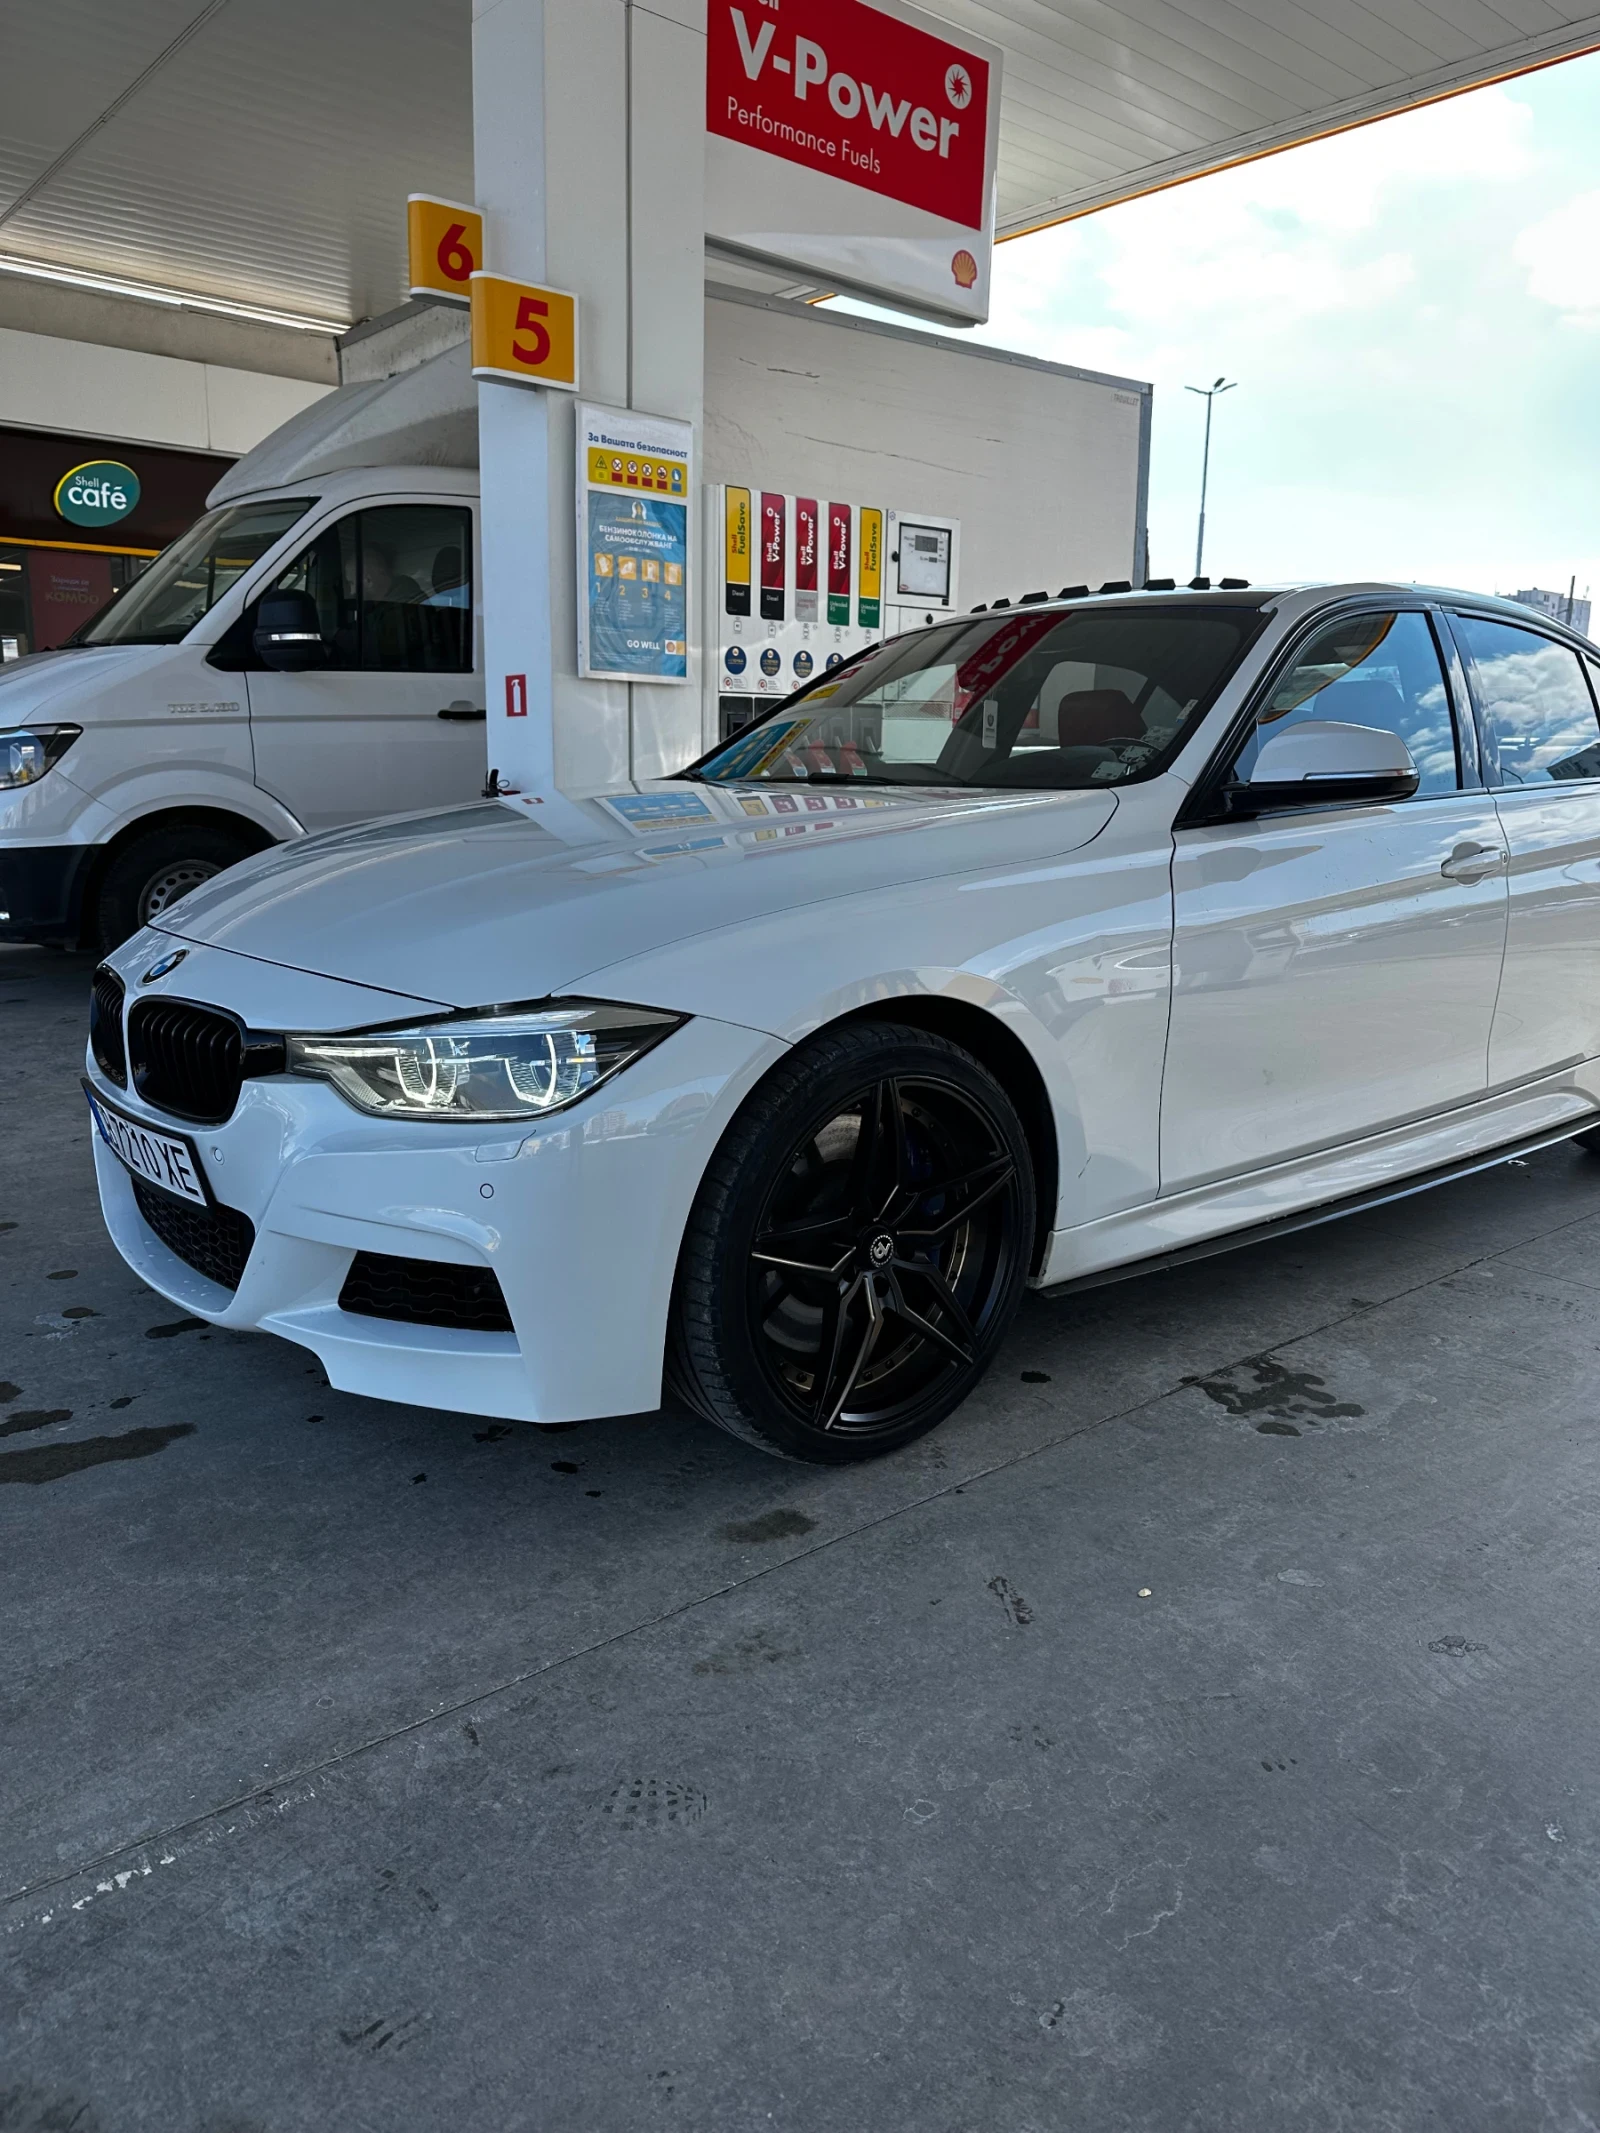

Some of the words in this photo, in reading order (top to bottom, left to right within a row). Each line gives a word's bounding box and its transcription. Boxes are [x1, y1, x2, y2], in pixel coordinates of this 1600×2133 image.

[730, 6, 960, 159] V-Power
[727, 95, 836, 158] Performance
[841, 139, 881, 175] Fuels
[437, 223, 474, 282] 6
[511, 296, 551, 366] 5
[588, 432, 599, 443] За
[601, 434, 635, 449] Вашата
[636, 441, 688, 459] безопасност
[67, 481, 128, 510] café
[75, 475, 100, 488] Shell
[738, 501, 746, 555] FuelSave
[772, 513, 781, 562] V-Power
[805, 517, 814, 565] V-Power
[838, 522, 847, 570] V-Power
[869, 522, 878, 571] FuelSave
[596, 582, 601, 593] 1
[619, 585, 626, 596] 2
[642, 588, 649, 599] 3
[664, 590, 671, 601] 4
[626, 639, 640, 648] GO
[640, 640, 660, 650] WELL
